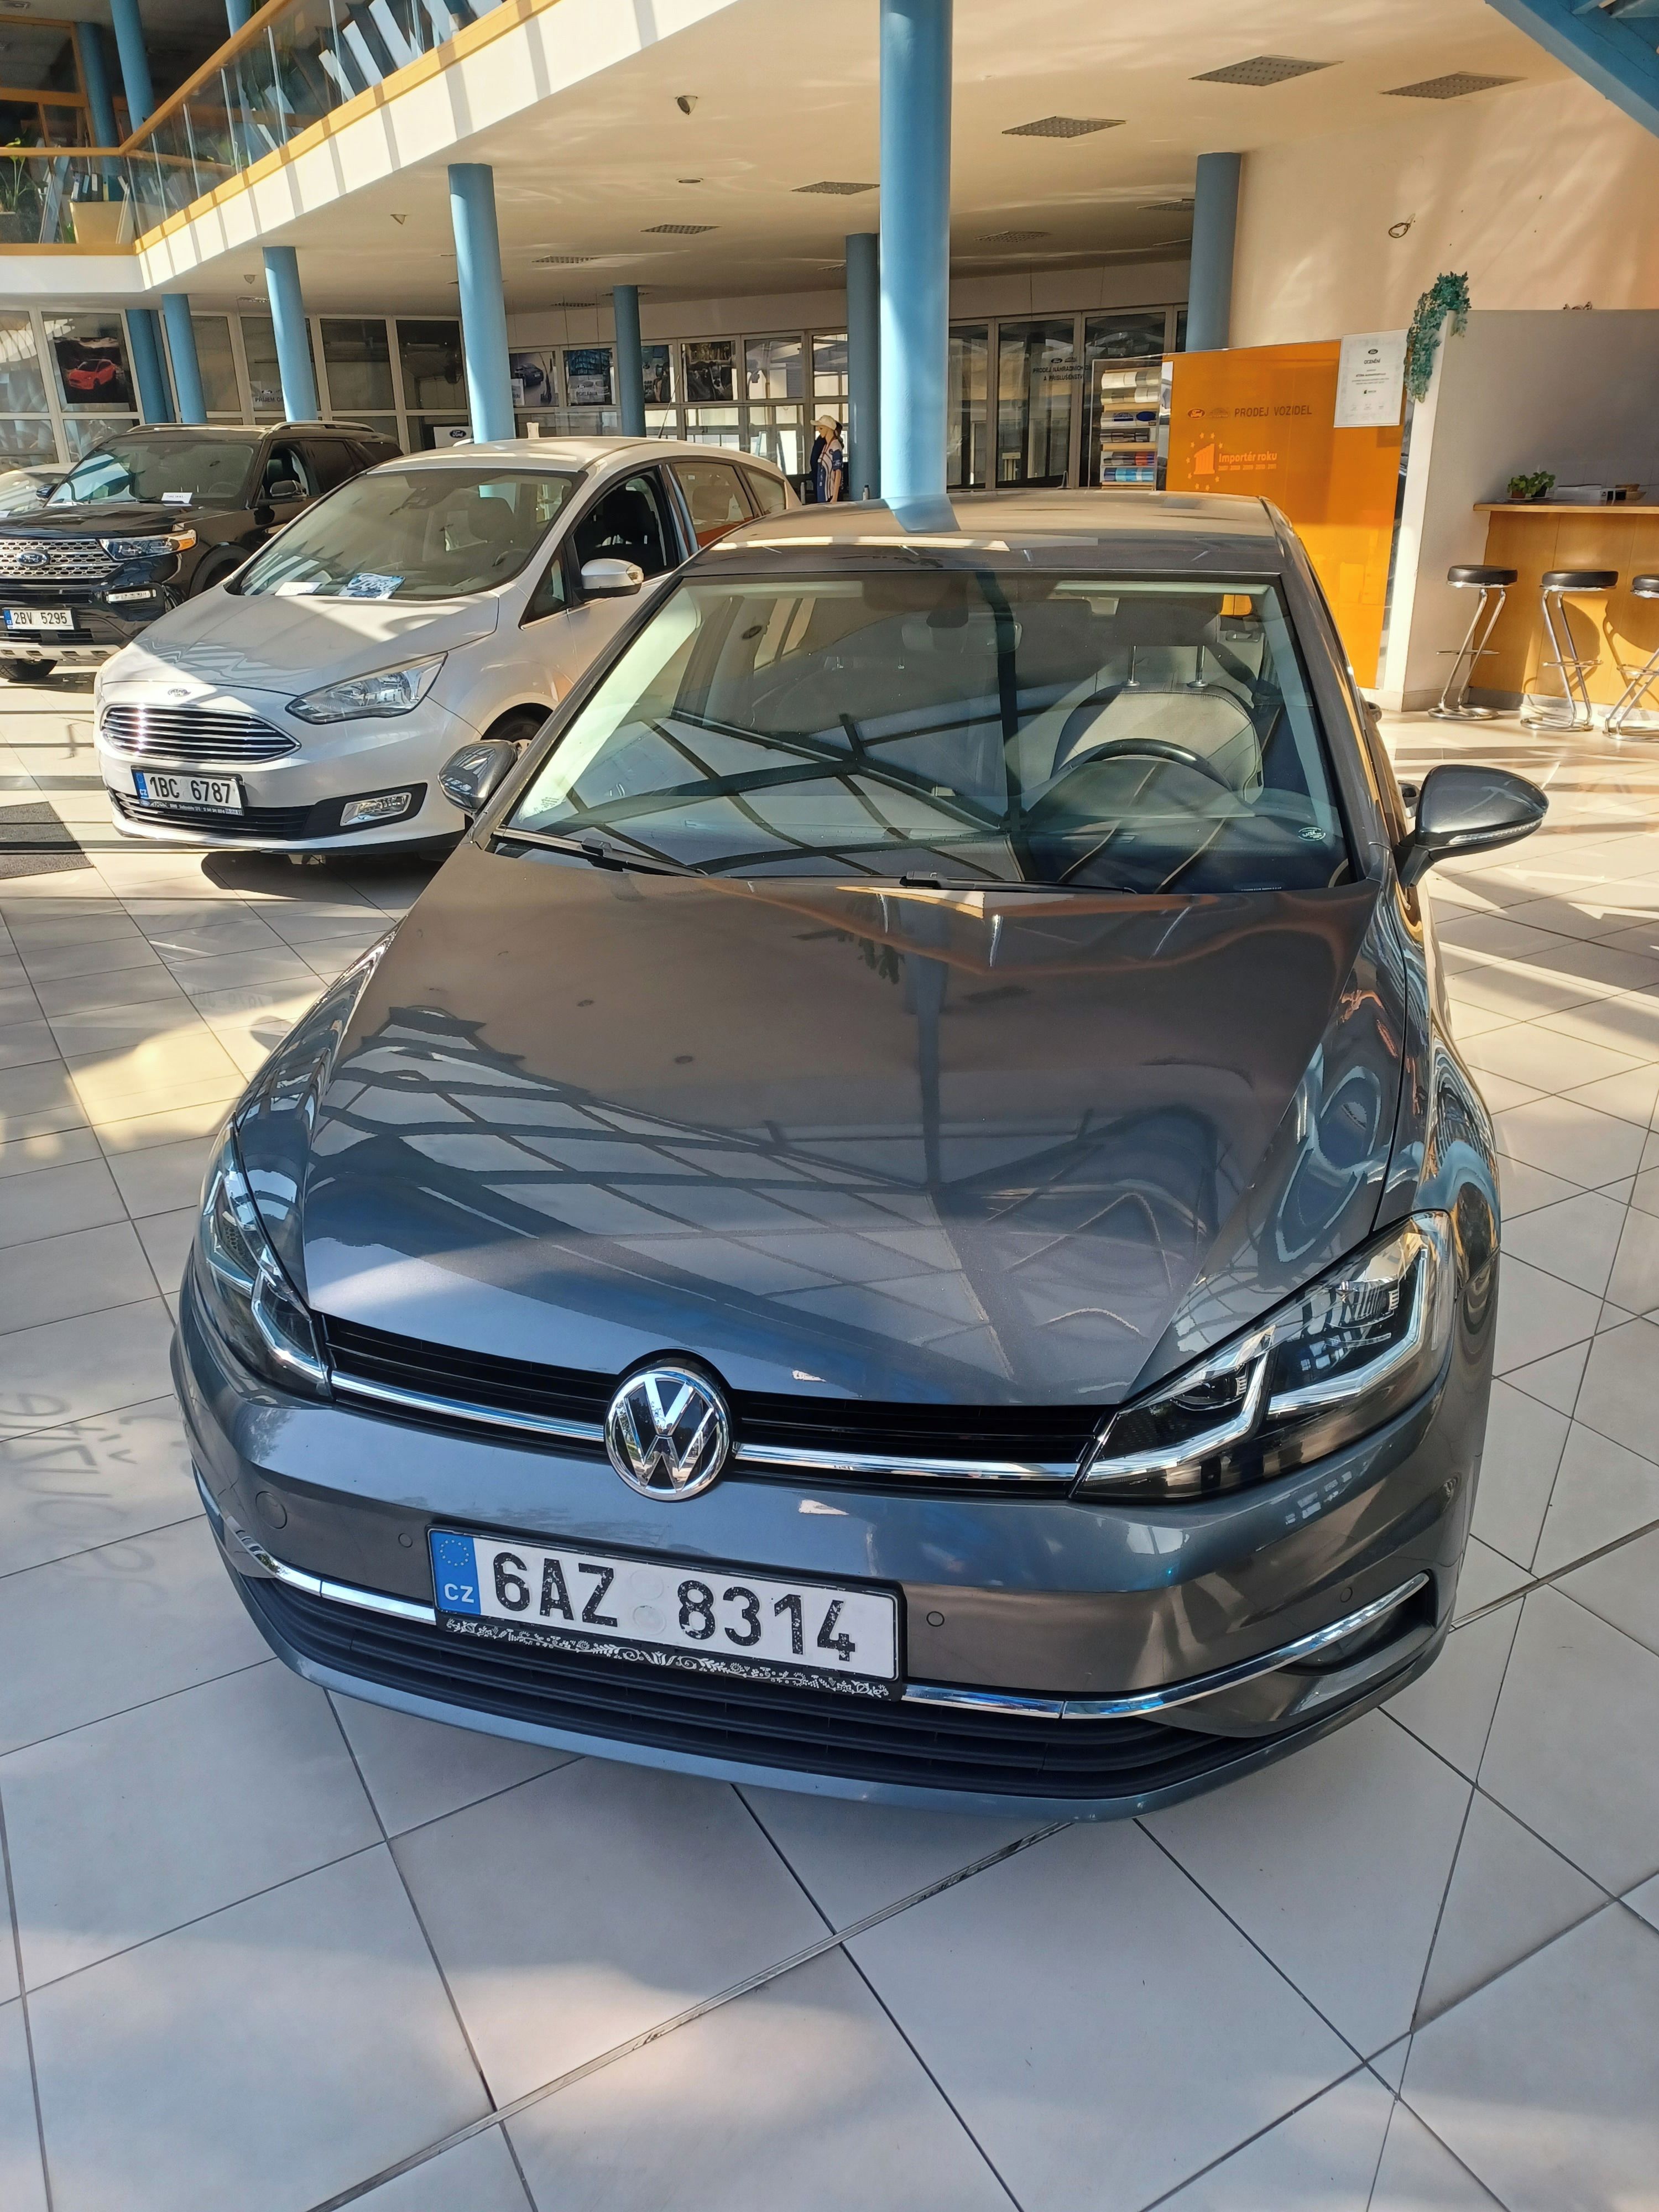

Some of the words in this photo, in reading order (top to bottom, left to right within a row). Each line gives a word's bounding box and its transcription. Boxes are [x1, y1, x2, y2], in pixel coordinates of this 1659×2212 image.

[1234, 407, 1270, 418] PRODEJ
[1274, 405, 1312, 416] VOZIDEL
[1219, 451, 1256, 463] Importér
[1258, 451, 1277, 461] roku
[13, 612, 32, 624] 2BV
[40, 612, 67, 624] 5295
[150, 776, 180, 798] 1BC
[190, 780, 230, 804] 6787
[444, 1582, 474, 1603] CZ
[492, 1551, 619, 1627] 6AZ
[677, 1579, 857, 1662] 8314
